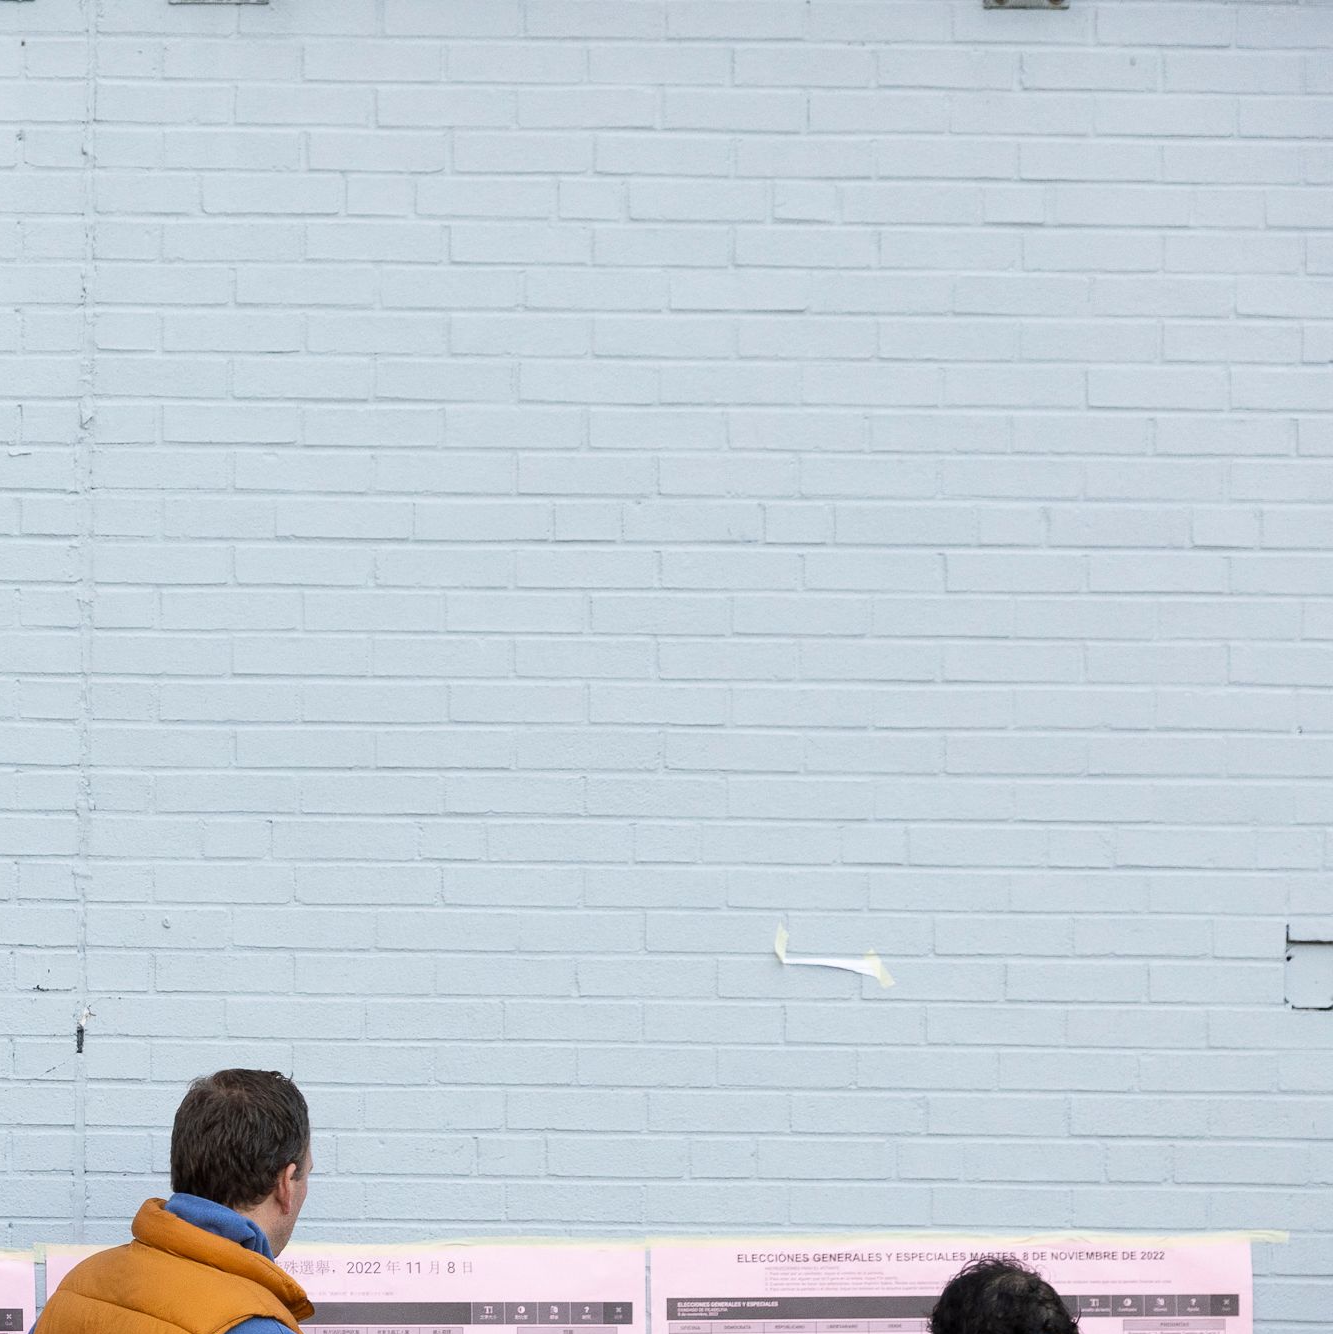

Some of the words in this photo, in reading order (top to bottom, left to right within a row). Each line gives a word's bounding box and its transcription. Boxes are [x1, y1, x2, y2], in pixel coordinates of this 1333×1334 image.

[813, 1253, 882, 1263] GENERALES
[886, 1253, 893, 1262] Y
[896, 1252, 967, 1262] ESPECIALES
[1022, 1252, 1029, 1261] 8
[1033, 1252, 1047, 1261] DE
[1051, 1251, 1119, 1261] NOVIEMBRE
[1121, 1251, 1137, 1260] DE
[1140, 1251, 1165, 1260] 2022
[346, 1261, 381, 1275] 2022
[386, 1260, 401, 1275] 年
[406, 1261, 421, 1274] 11
[429, 1260, 441, 1275] 月
[447, 1261, 456, 1274] 8
[463, 1261, 473, 1274] 日
